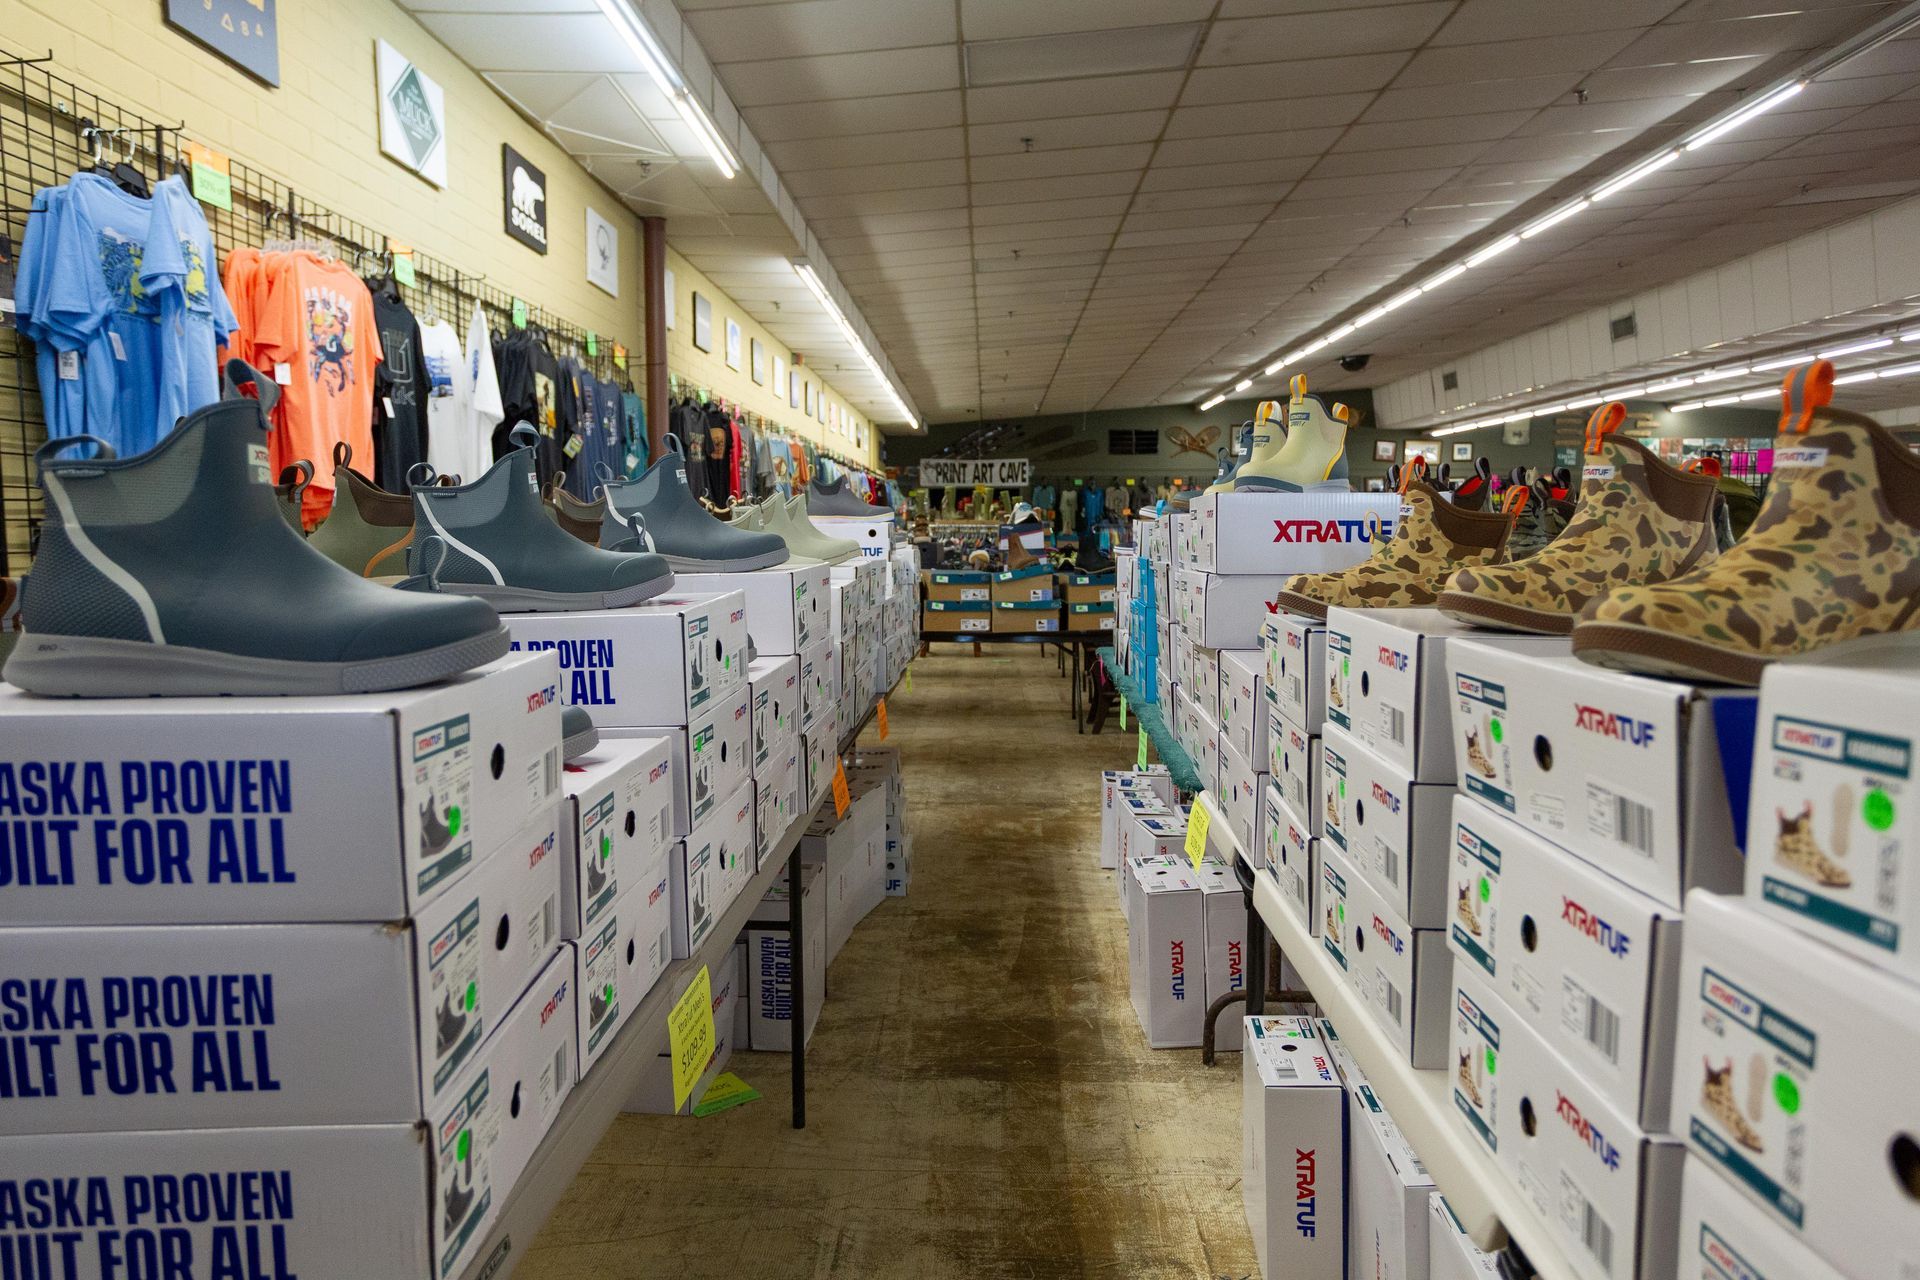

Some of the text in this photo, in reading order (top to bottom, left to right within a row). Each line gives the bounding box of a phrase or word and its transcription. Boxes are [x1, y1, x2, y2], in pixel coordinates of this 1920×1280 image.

[511, 207, 546, 244] SOREL
[935, 462, 1027, 483] PRINT ART CAVE
[1273, 519, 1393, 543] XTRATUF
[528, 639, 614, 669] OVEN
[571, 669, 616, 705] ALL
[1575, 702, 1655, 748] XTRATUF
[0, 760, 292, 816] ASKA PROVEN
[94, 819, 193, 885] FOR
[208, 818, 296, 884] ALL
[1562, 894, 1631, 960] XTRATUF
[761, 936, 776, 1020] ALASKA PROVEN
[1171, 939, 1185, 1001] XTRATUF
[102, 974, 275, 1028] PROVEN
[76, 1032, 177, 1096] FOR
[192, 1030, 281, 1093] ALL
[1556, 1087, 1620, 1172] XTRATUF
[124, 1170, 293, 1225] PROVEN
[1295, 1148, 1316, 1238] XTRATUF
[98, 1228, 193, 1280] FOR
[211, 1224, 297, 1280] ALL
